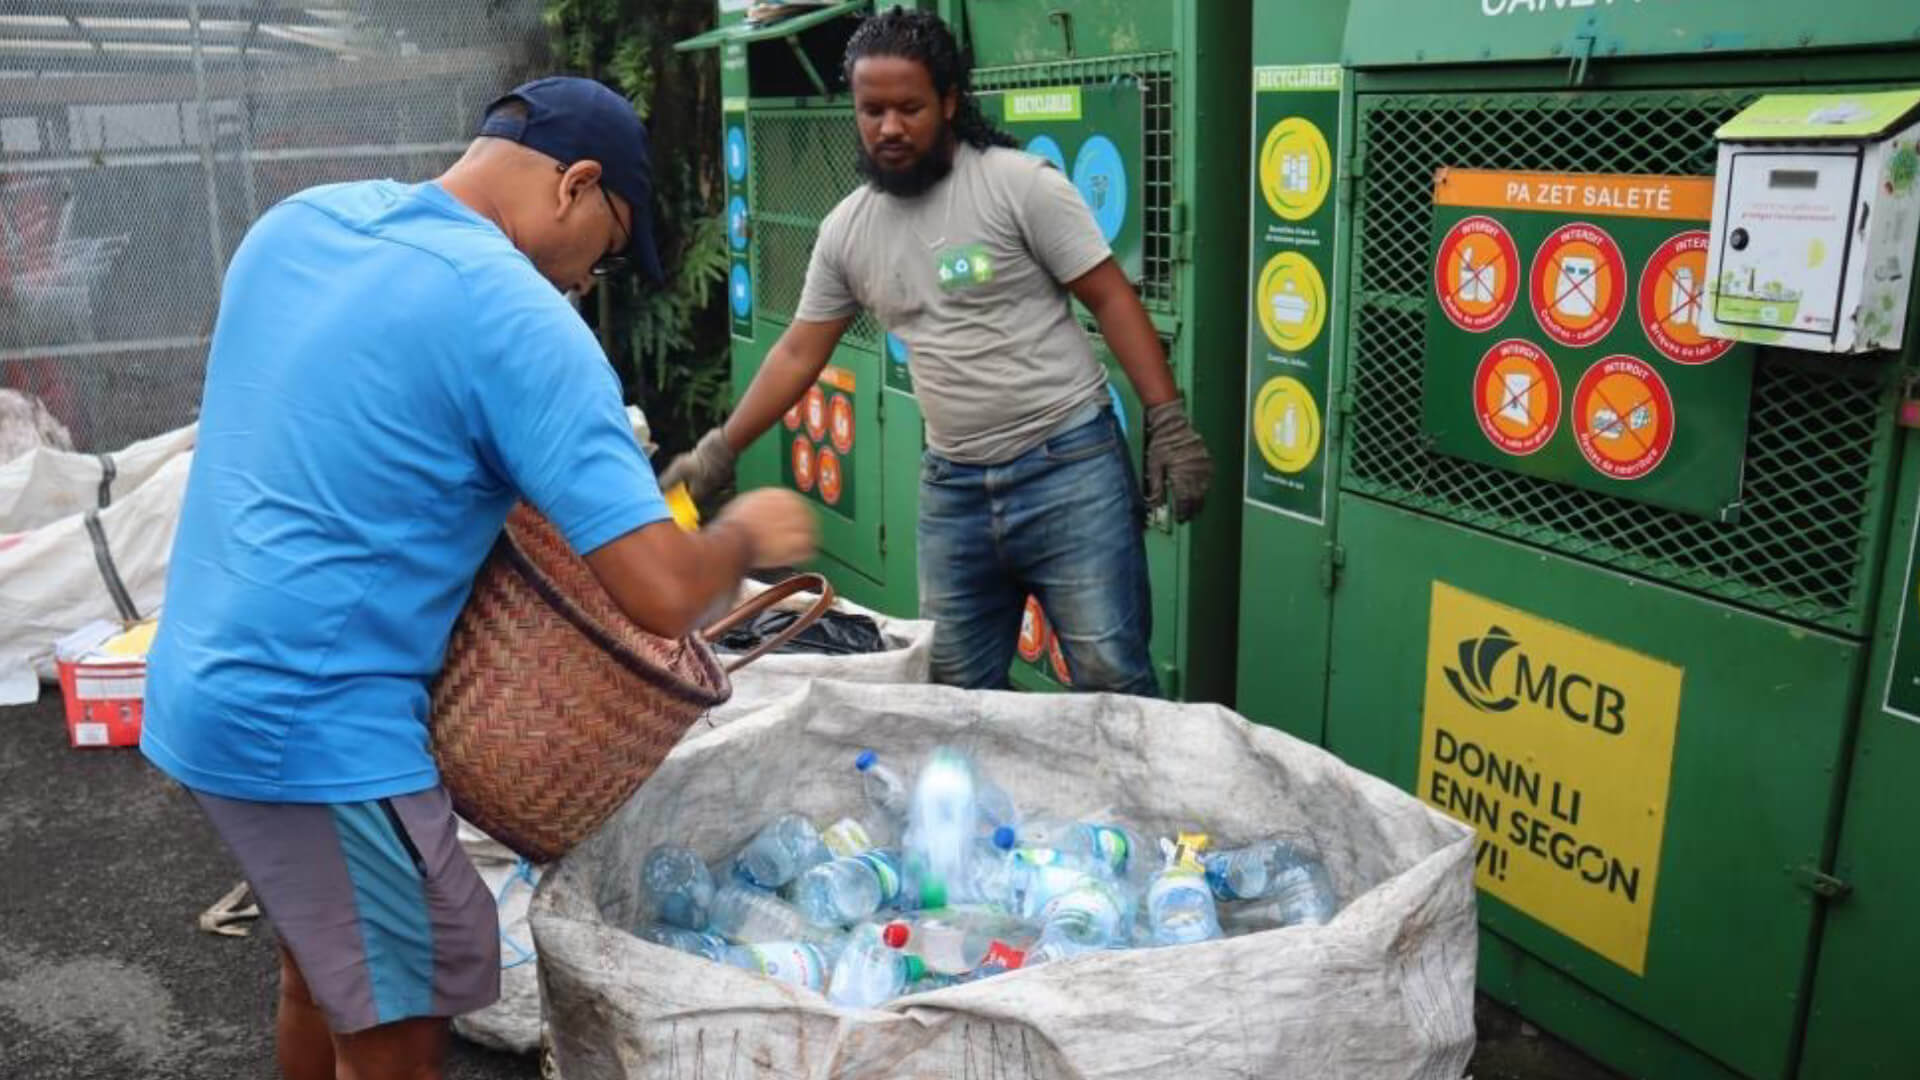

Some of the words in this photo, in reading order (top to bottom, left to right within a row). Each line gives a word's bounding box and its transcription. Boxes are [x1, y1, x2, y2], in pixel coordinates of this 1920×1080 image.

[1506, 182, 1530, 203] PA
[1537, 184, 1576, 204] ZET
[1583, 184, 1672, 210] SALETÉ
[1462, 221, 1499, 237] INTERDIT
[1560, 229, 1603, 246] INTERDIT
[1501, 344, 1540, 361] INTERDIT
[1604, 362, 1649, 379] INTERDIT
[1514, 653, 1626, 736] MCB
[1433, 728, 1541, 807] DONN
[1550, 781, 1581, 826] LI
[1430, 771, 1499, 833] ENN
[1508, 810, 1640, 904] SEGON
